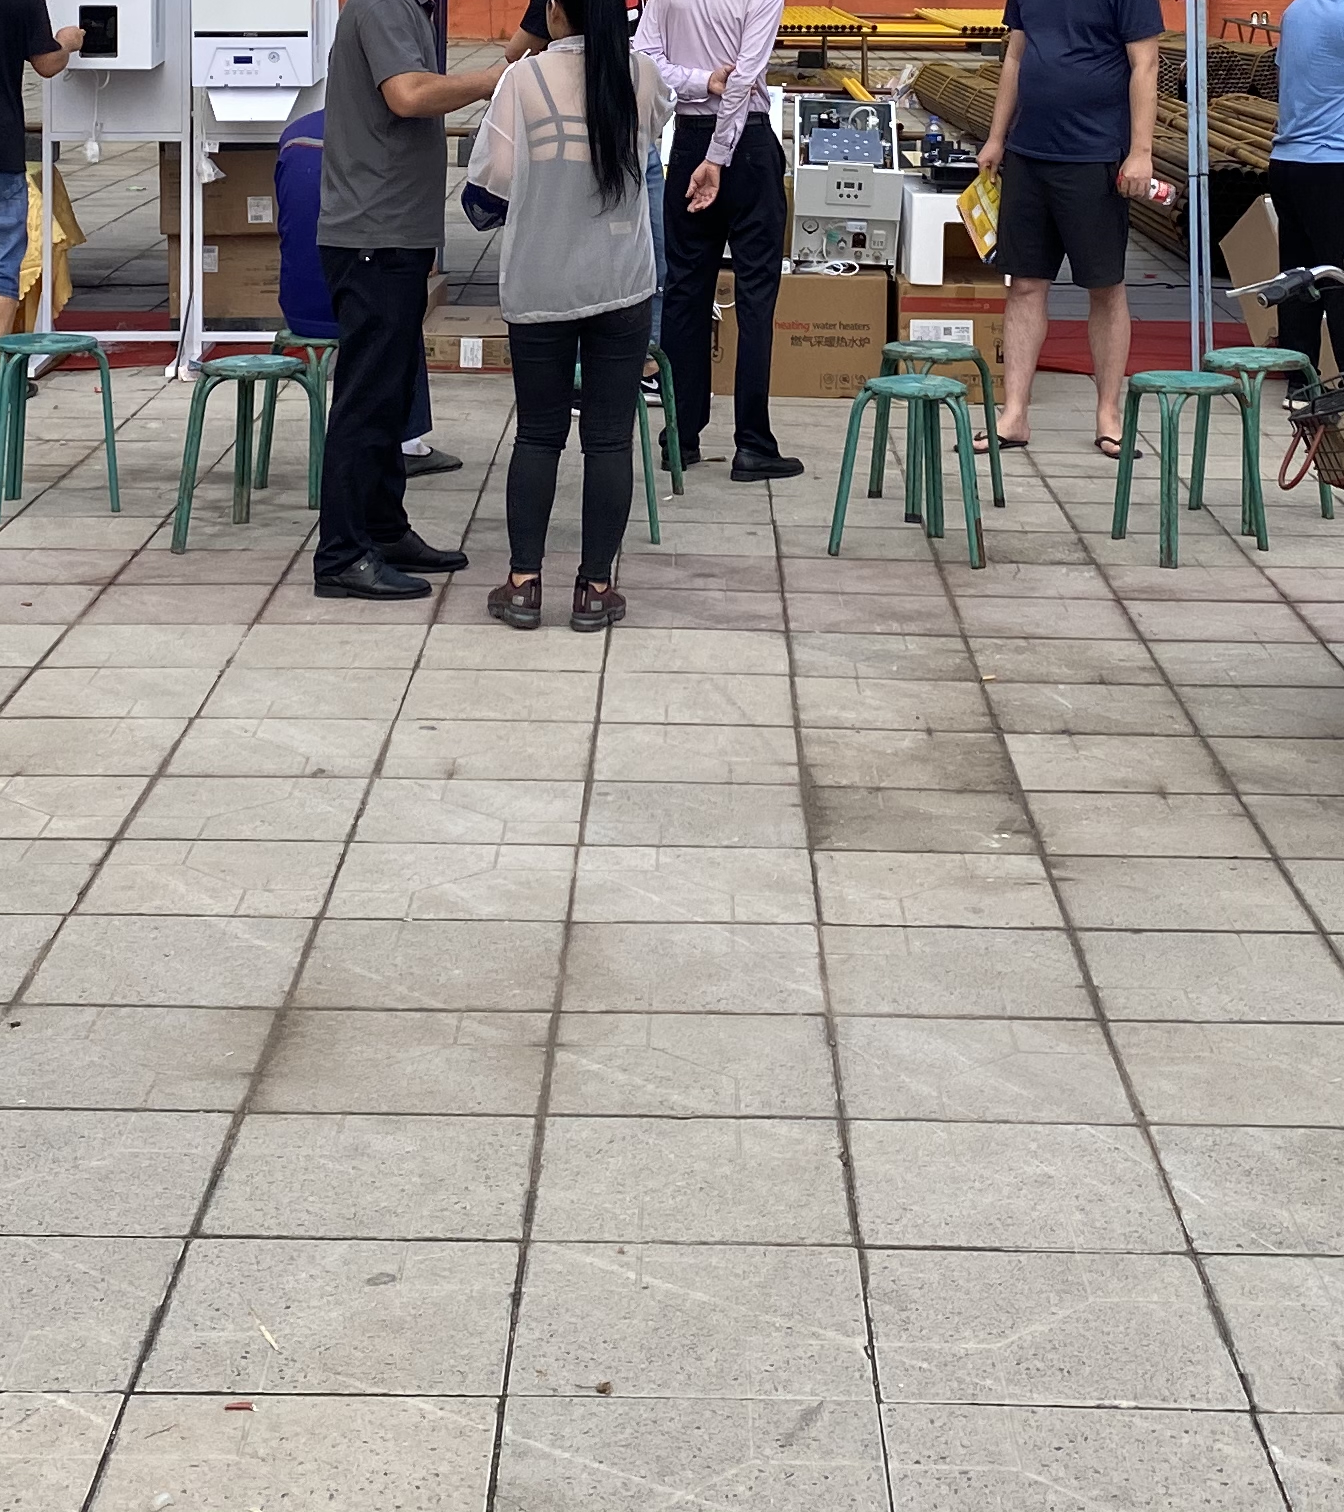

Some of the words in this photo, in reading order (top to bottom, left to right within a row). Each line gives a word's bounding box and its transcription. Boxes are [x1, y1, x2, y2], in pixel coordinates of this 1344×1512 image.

[775, 319, 810, 333] heating
[812, 321, 837, 331] water
[838, 320, 871, 331] heaters
